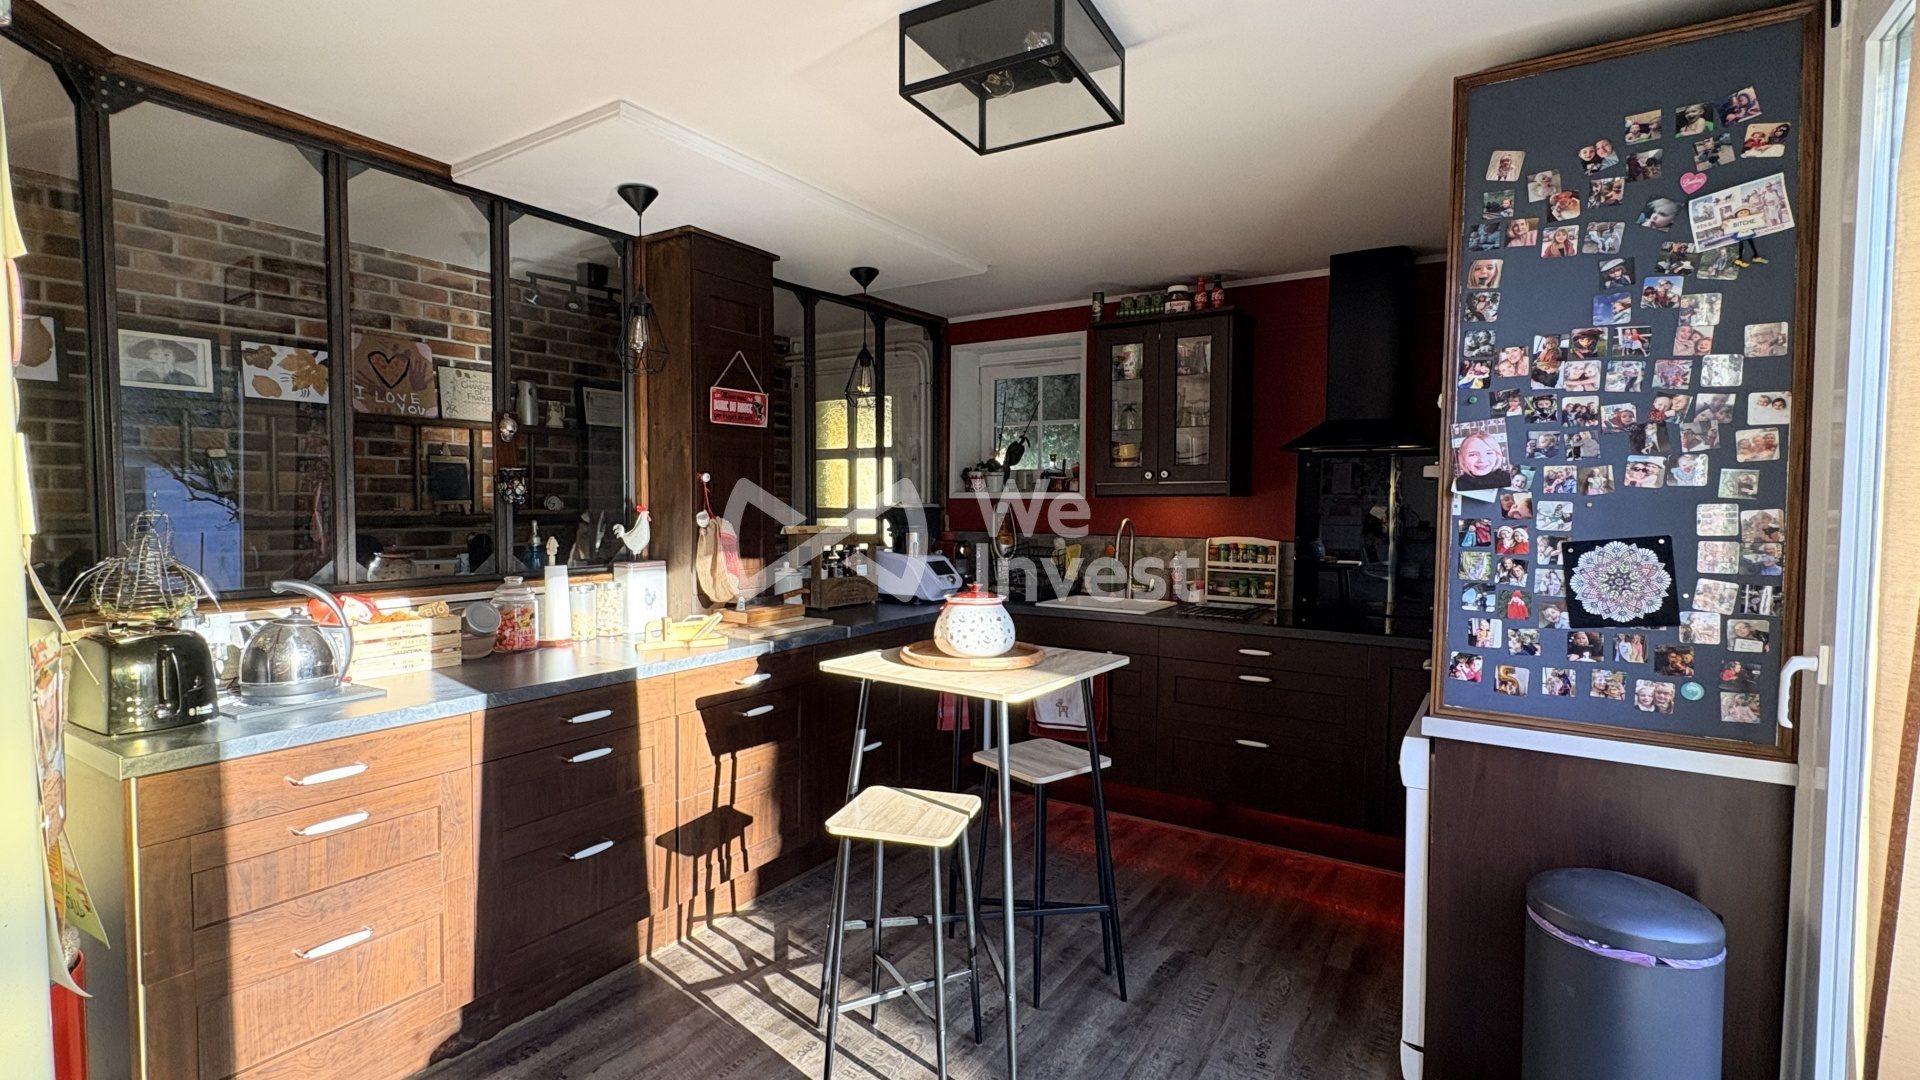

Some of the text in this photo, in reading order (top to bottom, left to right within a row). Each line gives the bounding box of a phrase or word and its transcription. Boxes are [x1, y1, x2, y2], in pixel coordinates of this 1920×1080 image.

[354, 385, 421, 405] I LOVE
[396, 402, 426, 415] YOU
